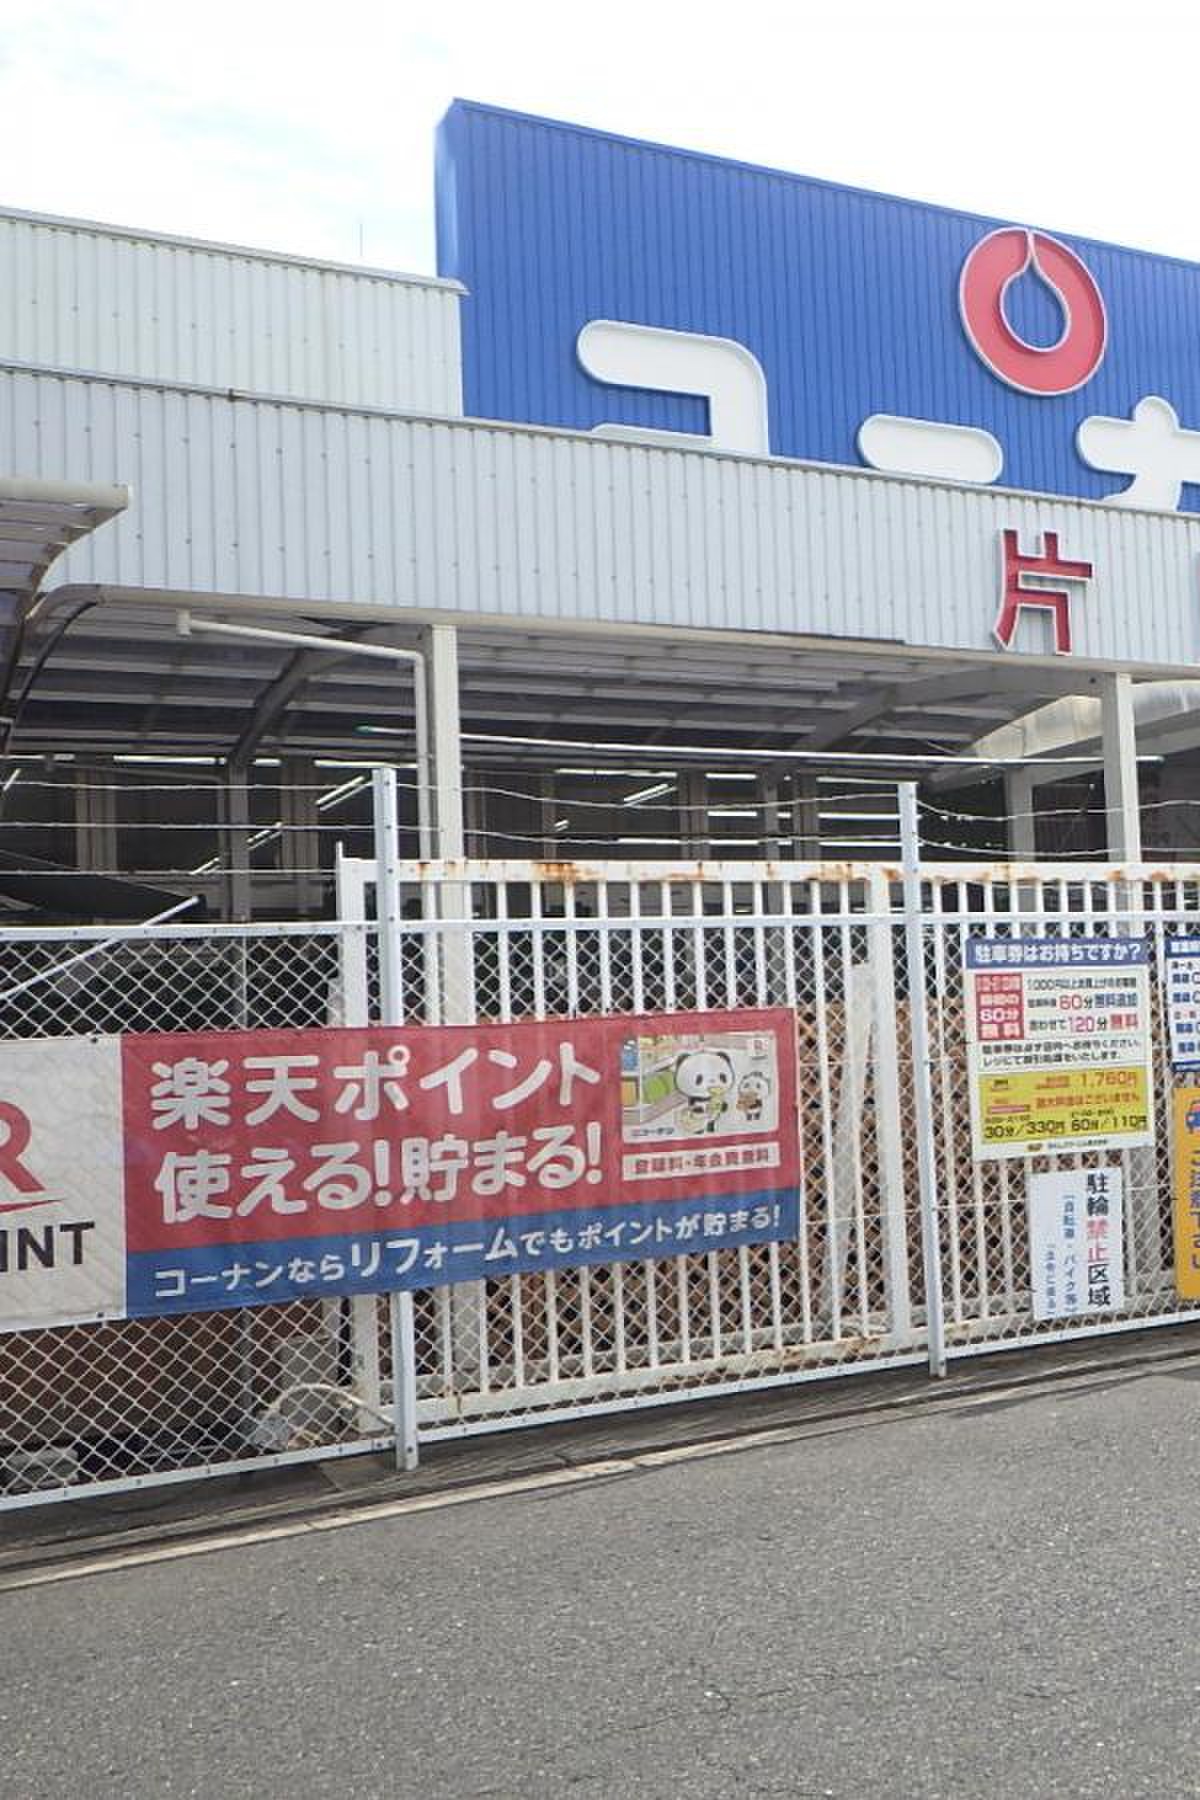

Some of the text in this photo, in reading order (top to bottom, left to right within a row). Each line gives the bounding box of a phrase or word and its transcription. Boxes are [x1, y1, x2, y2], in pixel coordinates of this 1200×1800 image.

[150, 1042, 601, 1131] 楽天ポイント
[154, 1122, 602, 1224] 使える!貯まる!
[155, 1204, 782, 1299] コーナンならリフォームでもポイントが貯まる!
[1086, 1172, 1111, 1308] 駐輪禁止区域
